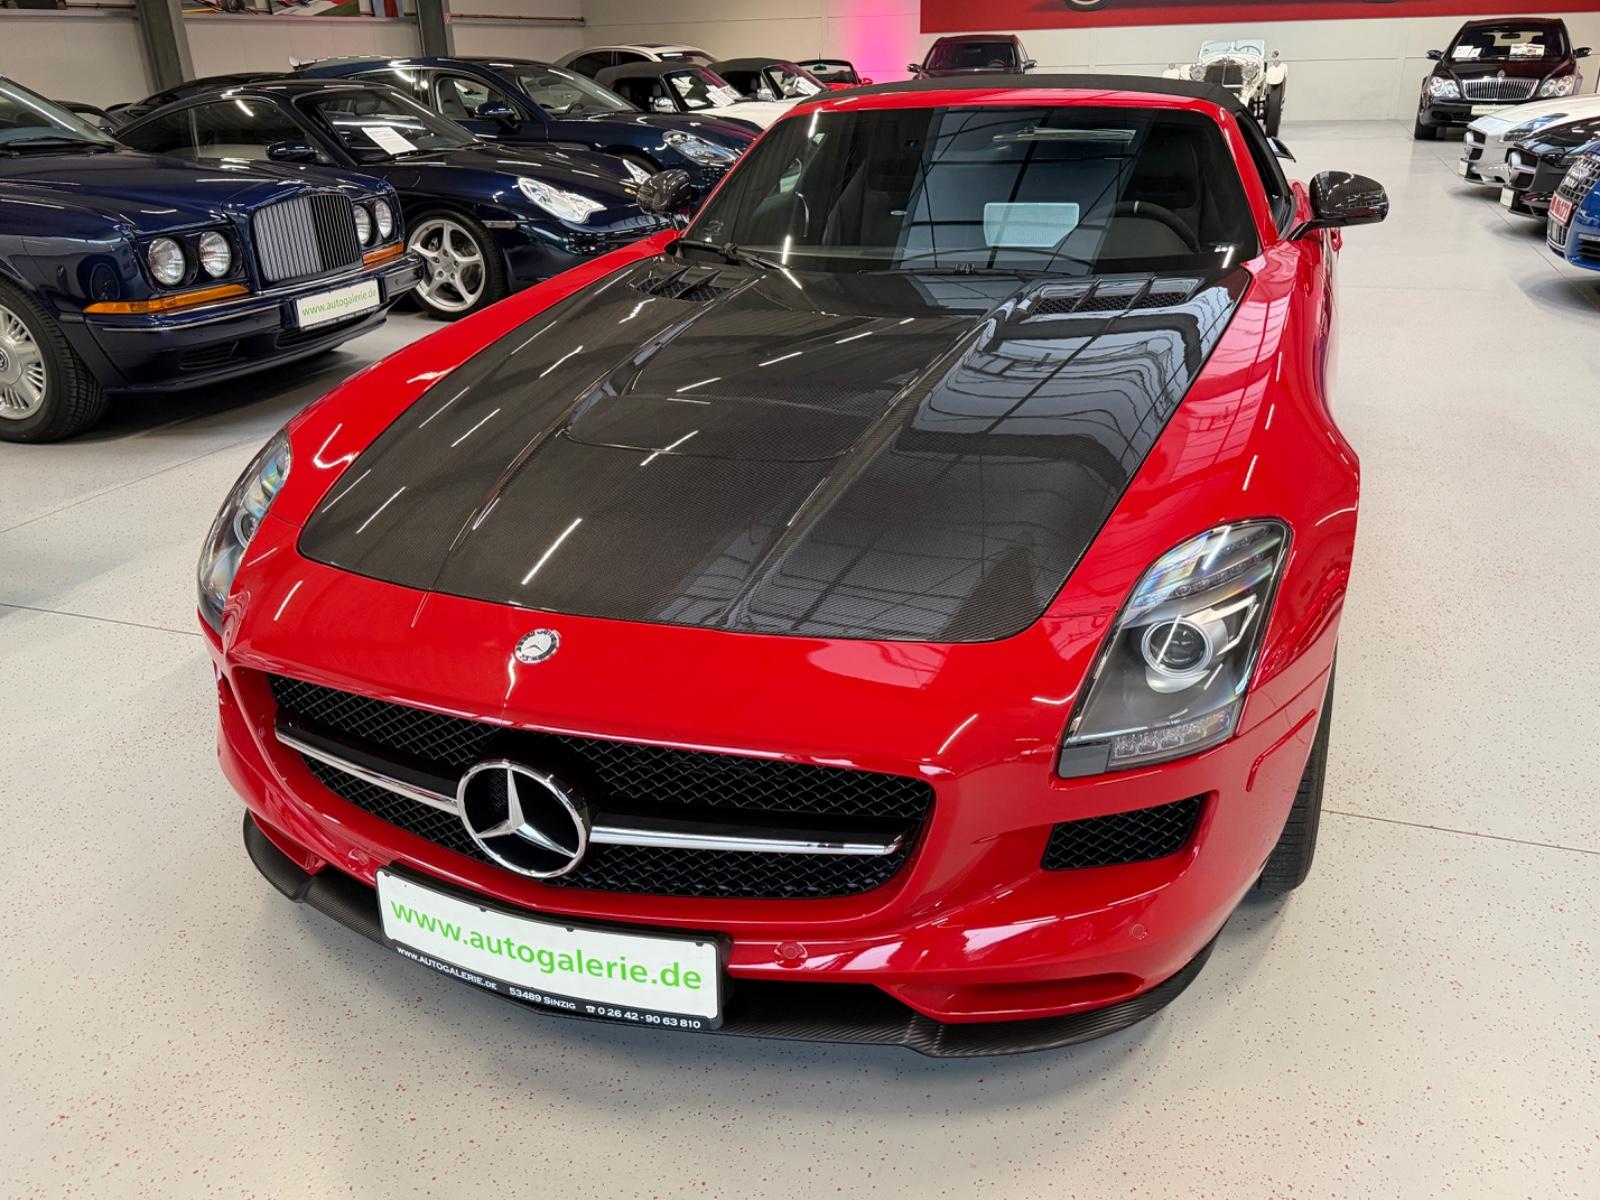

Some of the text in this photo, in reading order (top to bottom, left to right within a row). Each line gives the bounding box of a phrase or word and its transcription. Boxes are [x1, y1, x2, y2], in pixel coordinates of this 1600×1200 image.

[302, 288, 377, 316] www.autogalerie.de
[391, 900, 701, 990] www.autogalerie.de
[509, 987, 541, 1002] 53489
[679, 1019, 701, 1028] 810
